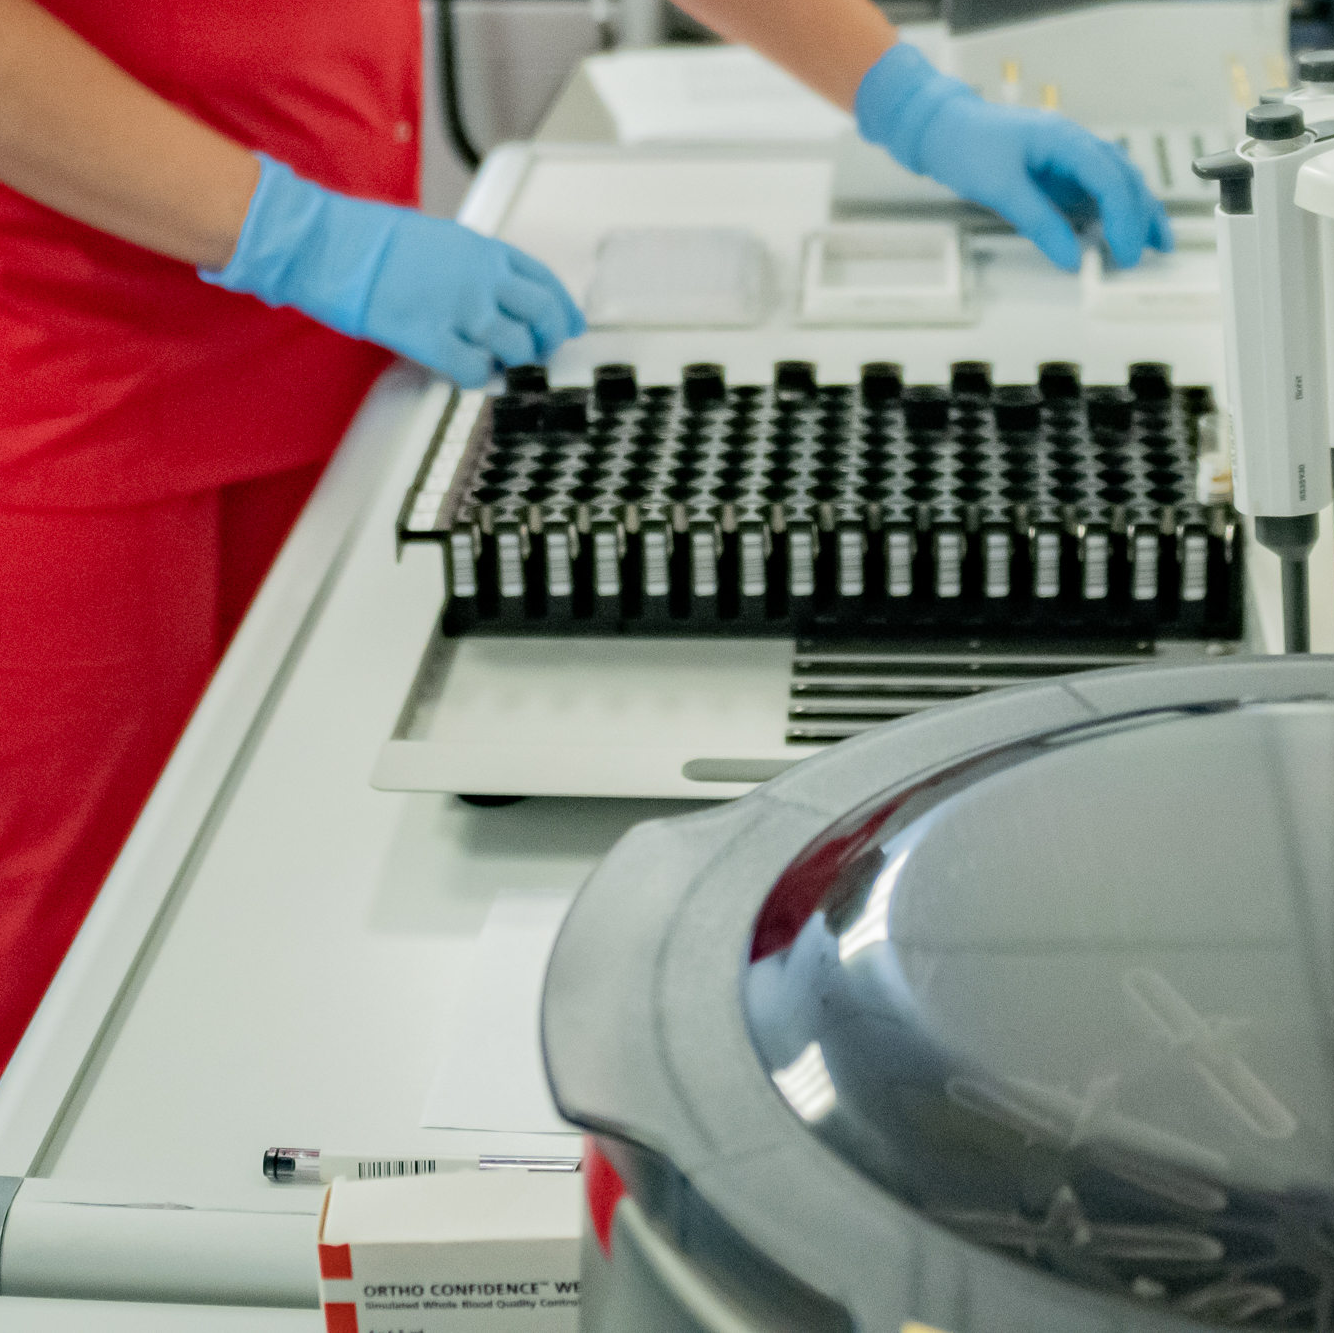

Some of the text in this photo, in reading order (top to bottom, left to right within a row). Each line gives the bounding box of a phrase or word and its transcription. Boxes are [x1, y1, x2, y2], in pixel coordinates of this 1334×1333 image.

[363, 1284, 425, 1297] ORTHO
[422, 1300, 458, 1309] Whole
[461, 1299, 493, 1309] Blood
[496, 1299, 536, 1310] Quality
